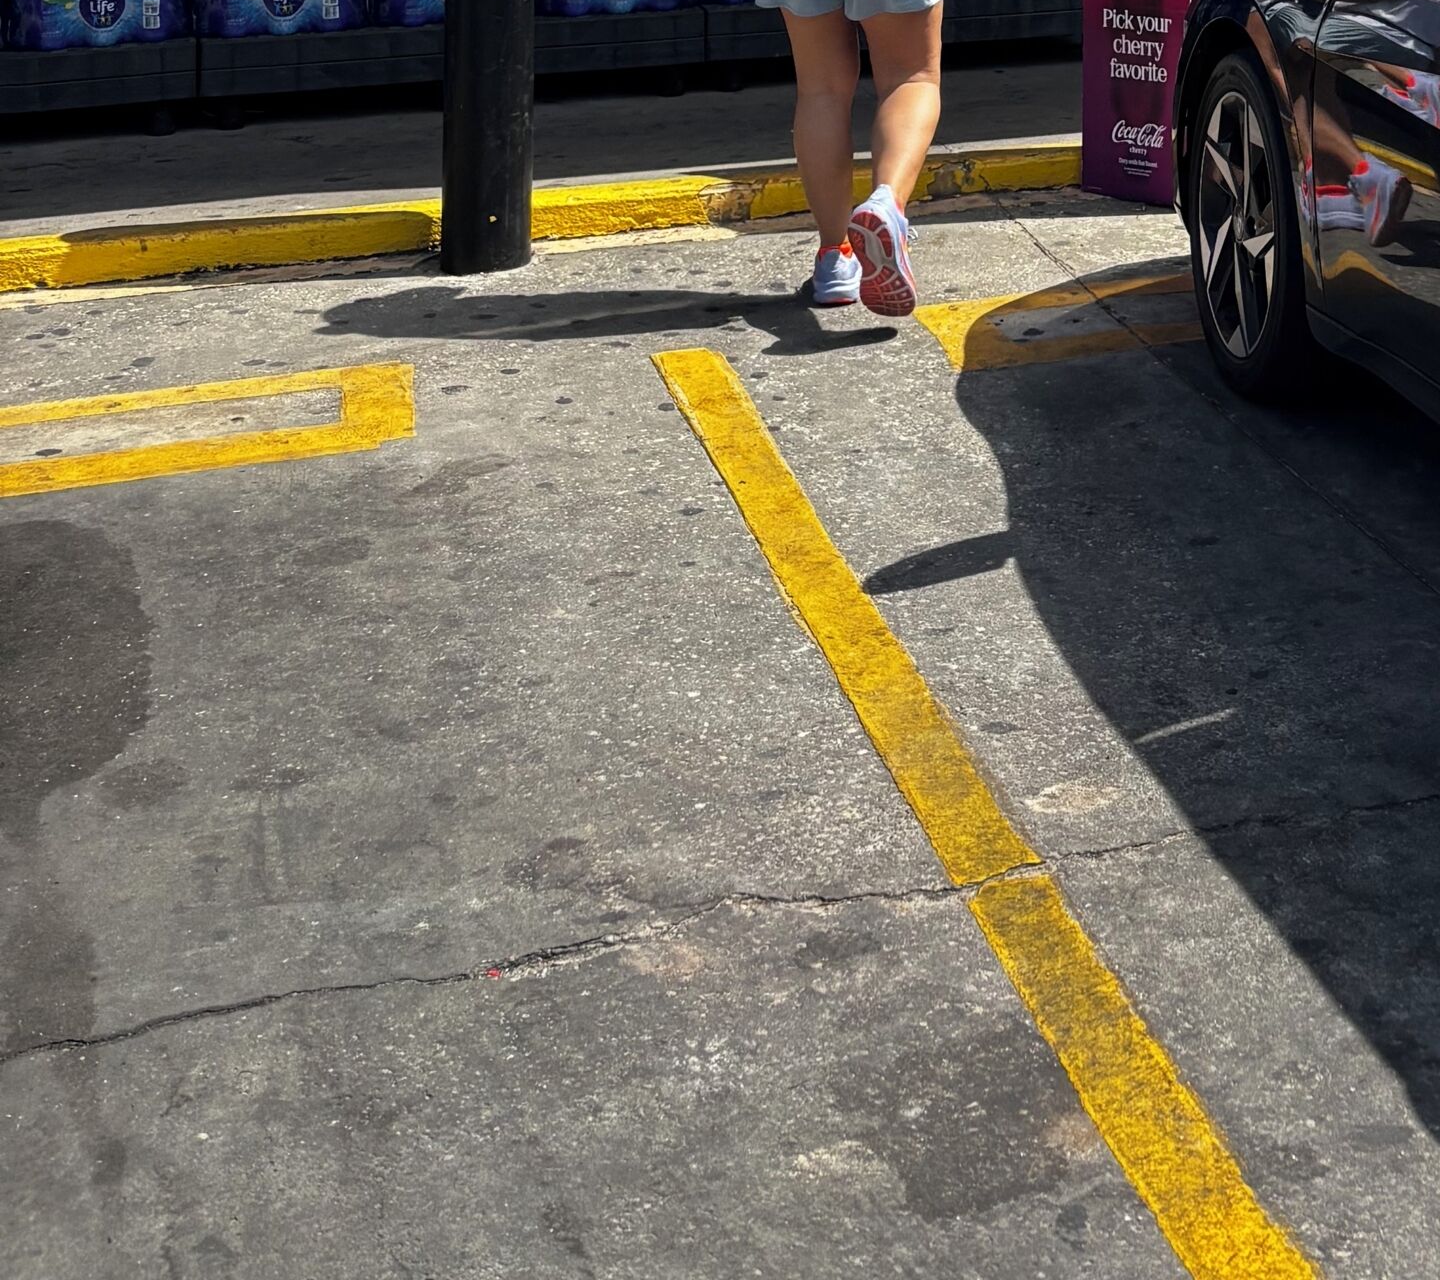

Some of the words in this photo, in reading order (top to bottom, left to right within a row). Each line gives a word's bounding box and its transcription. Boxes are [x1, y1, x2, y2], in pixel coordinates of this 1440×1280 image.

[89, 1, 115, 16] Life
[1103, 8, 1135, 30] Pick
[1136, 14, 1172, 35] your
[1113, 34, 1164, 61] cherry
[1110, 58, 1168, 83] favorite
[1111, 119, 1167, 148] Coca-Cola
[1129, 146, 1147, 156] cherry
